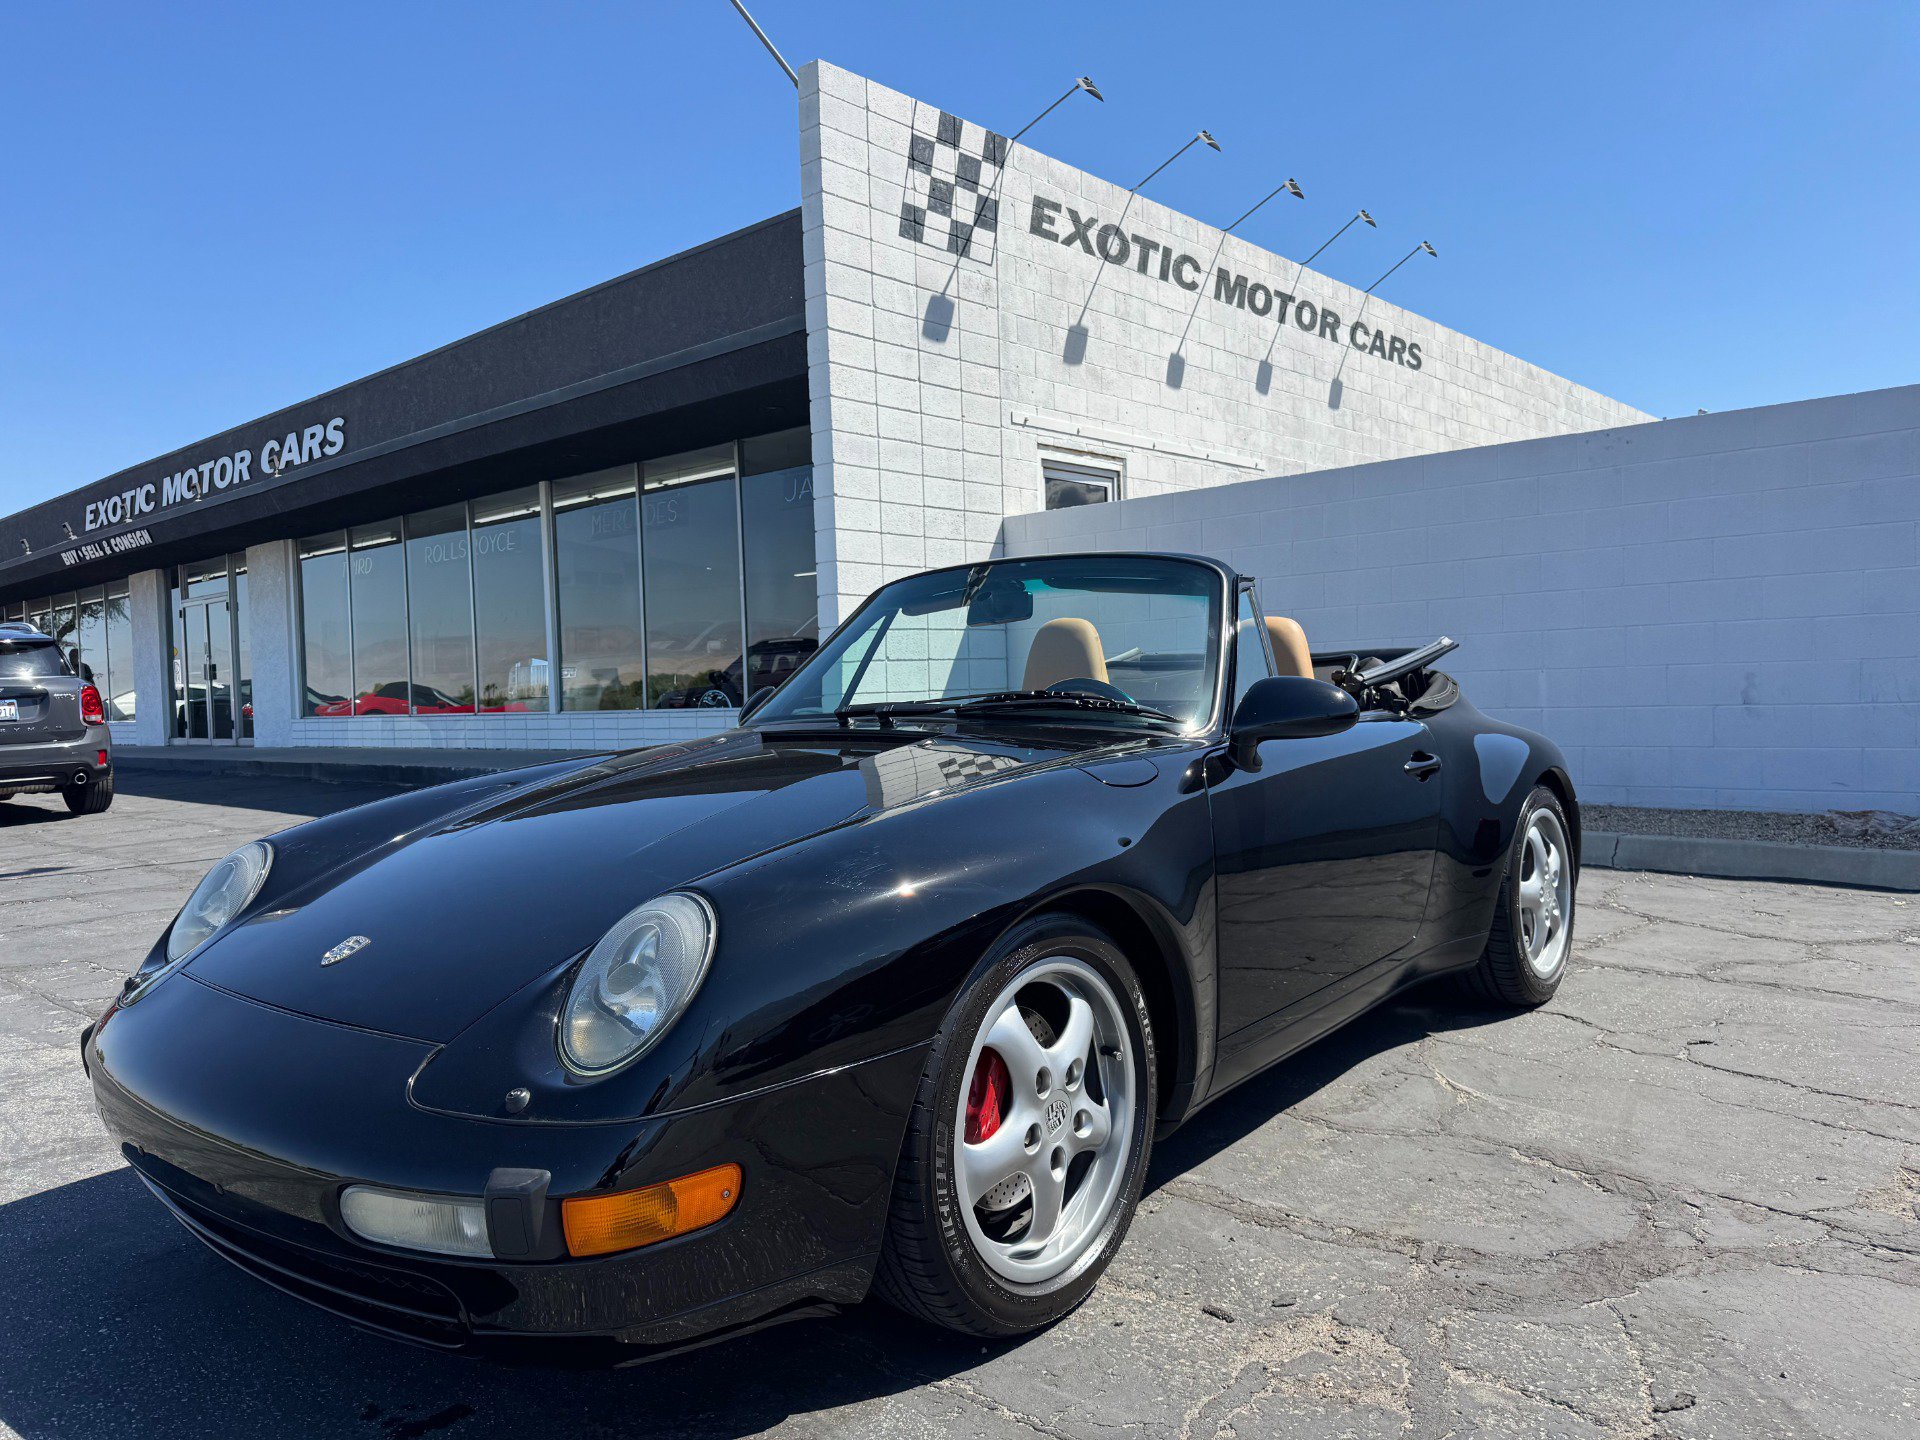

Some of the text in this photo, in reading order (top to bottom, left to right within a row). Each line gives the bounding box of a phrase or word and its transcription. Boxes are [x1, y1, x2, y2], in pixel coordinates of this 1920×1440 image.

[1029, 194, 1422, 372] EXOTIC MOTOR CARS
[85, 417, 345, 532] EXOTIC MOTOR CARS
[61, 529, 152, 566] BUY SELL & CONSIGN
[424, 530, 516, 564] ROLLS OYCE
[591, 500, 677, 535] MERCDES
[936, 1128, 959, 1251] MICHELIN
